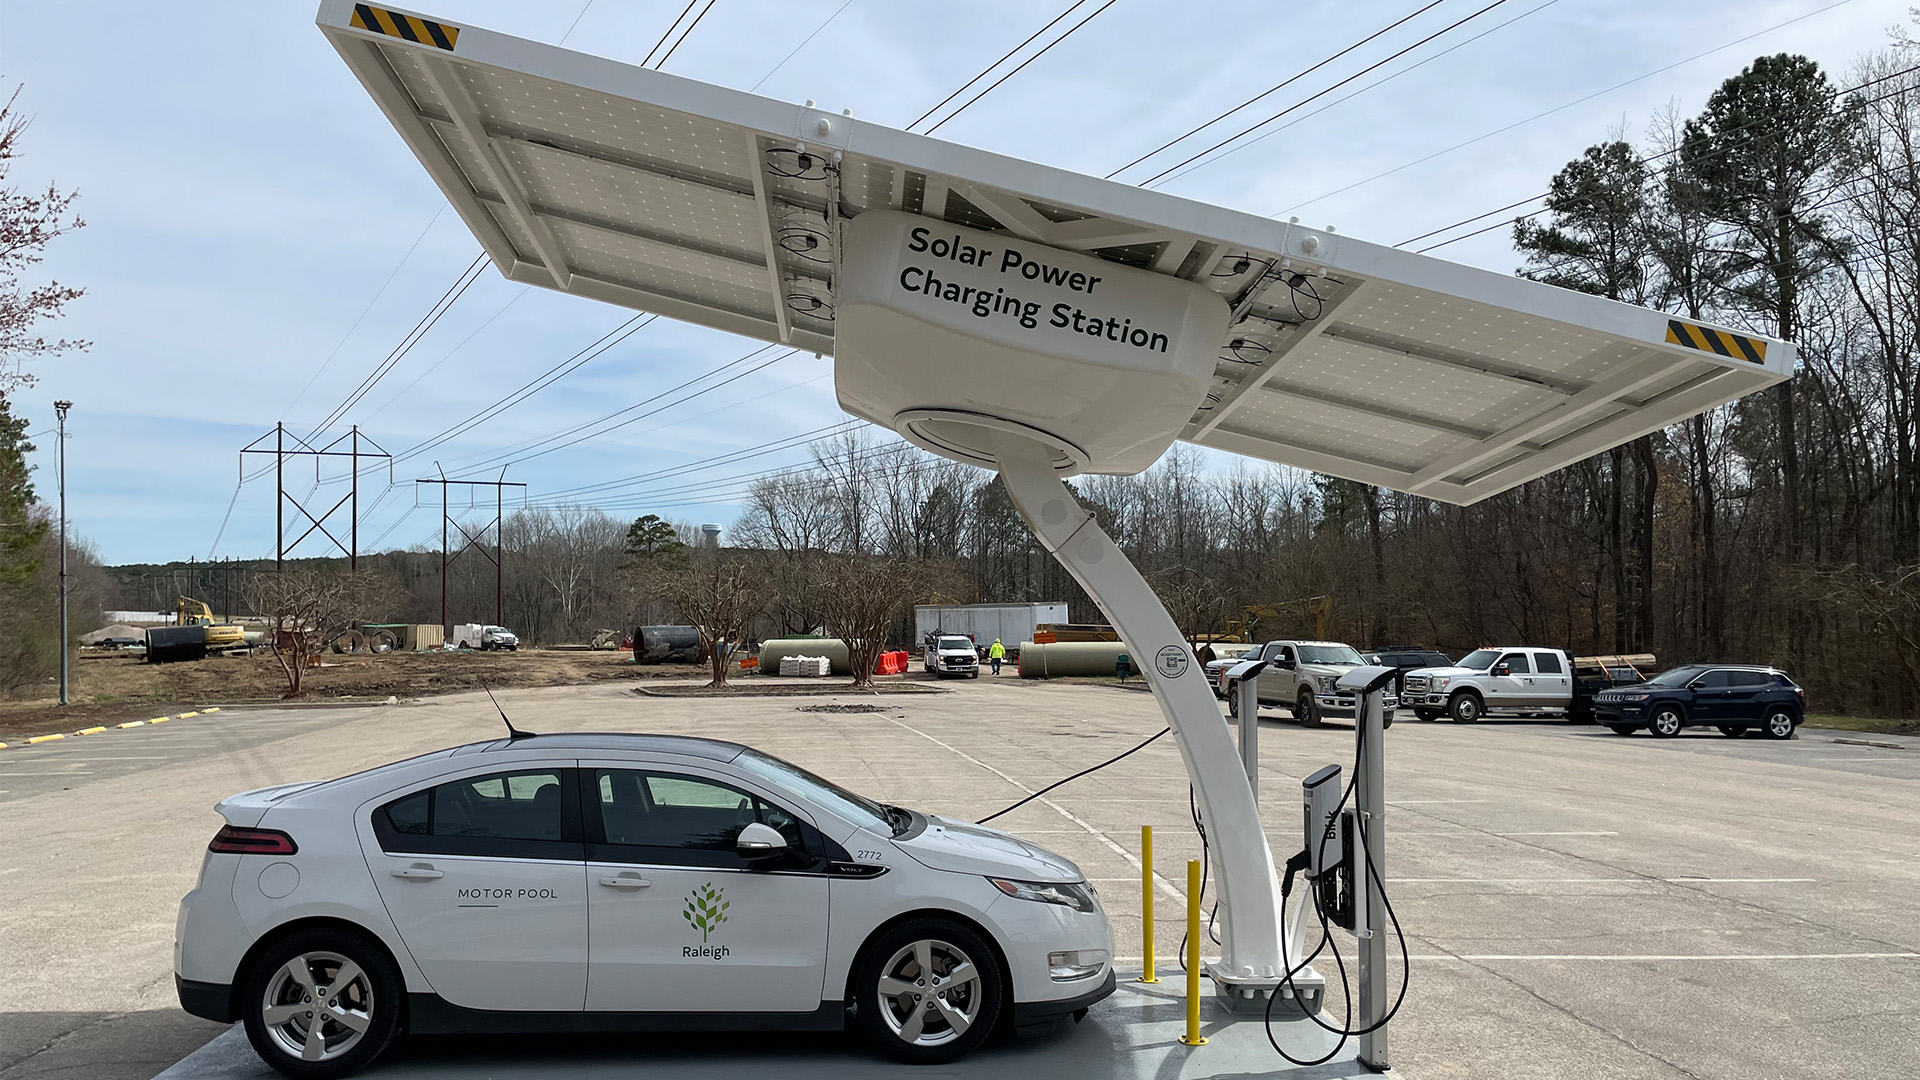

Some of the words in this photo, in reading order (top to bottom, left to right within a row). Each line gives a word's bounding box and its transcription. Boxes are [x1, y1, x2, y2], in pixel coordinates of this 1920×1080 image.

[908, 227, 992, 268] Solar
[1000, 249, 1102, 294] Power
[900, 267, 1041, 329] Charging
[1049, 303, 1169, 353] Station
[858, 850, 882, 861] 2772
[458, 889, 512, 898] MOTOR
[518, 889, 557, 898] POOL
[682, 945, 730, 960] Raleigh
